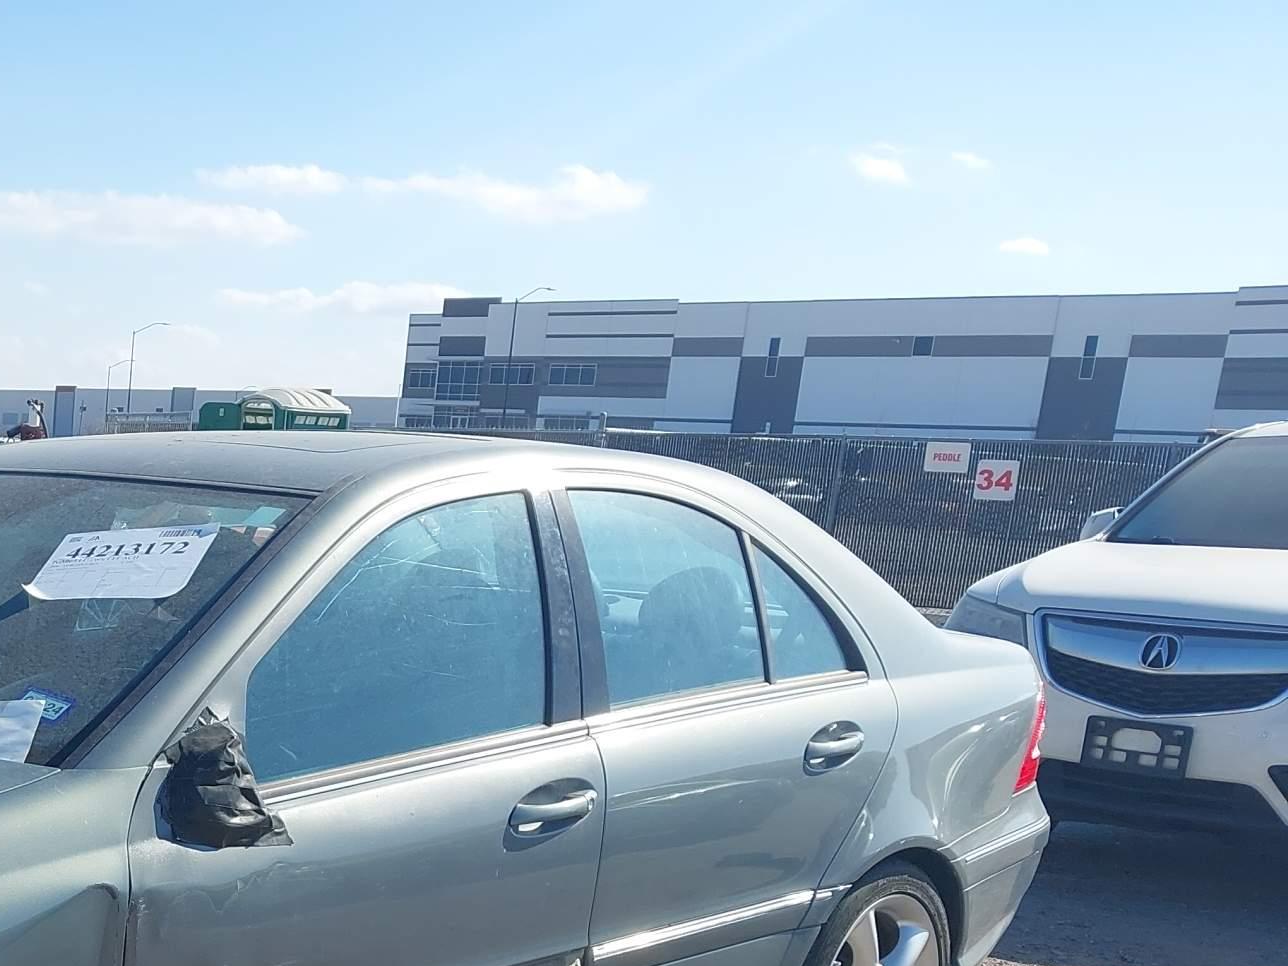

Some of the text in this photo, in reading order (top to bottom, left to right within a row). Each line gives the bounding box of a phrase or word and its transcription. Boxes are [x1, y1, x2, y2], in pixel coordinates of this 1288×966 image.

[933, 452, 962, 462] PEDDLE
[976, 469, 1013, 491] 34
[66, 541, 190, 559] 44213172
